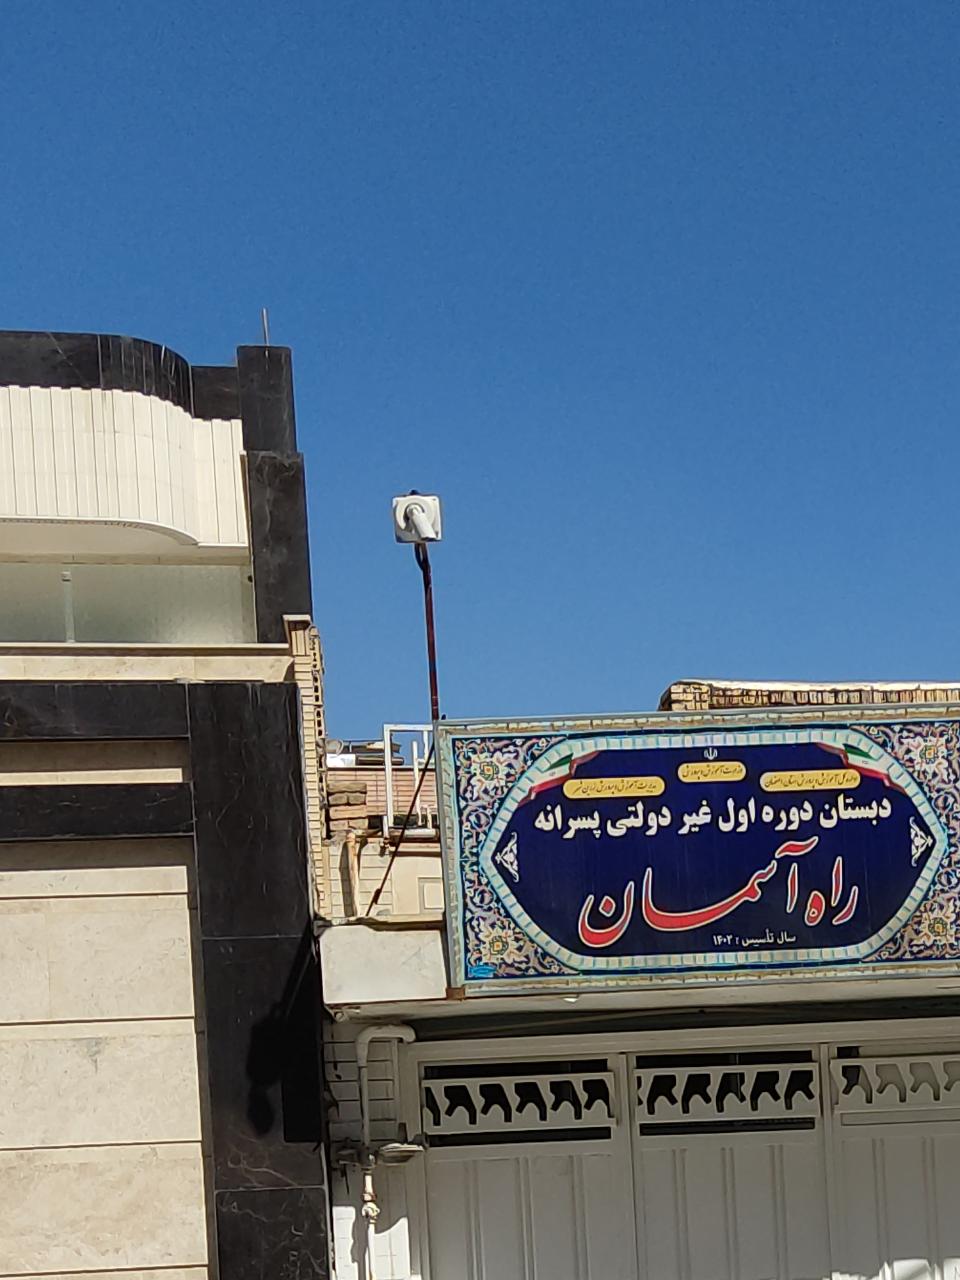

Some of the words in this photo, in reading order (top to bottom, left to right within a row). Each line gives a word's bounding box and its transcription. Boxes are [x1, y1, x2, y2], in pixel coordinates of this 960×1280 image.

[534, 804, 602, 839] پسرانه
[606, 800, 672, 837] دولتی
[677, 800, 712, 834] غیر
[718, 797, 756, 832] اول
[761, 800, 814, 831] دوره
[819, 793, 892, 829] دبستان
[578, 836, 819, 948] آسمان
[804, 856, 859, 926] راه
[777, 931, 797, 945] سال
